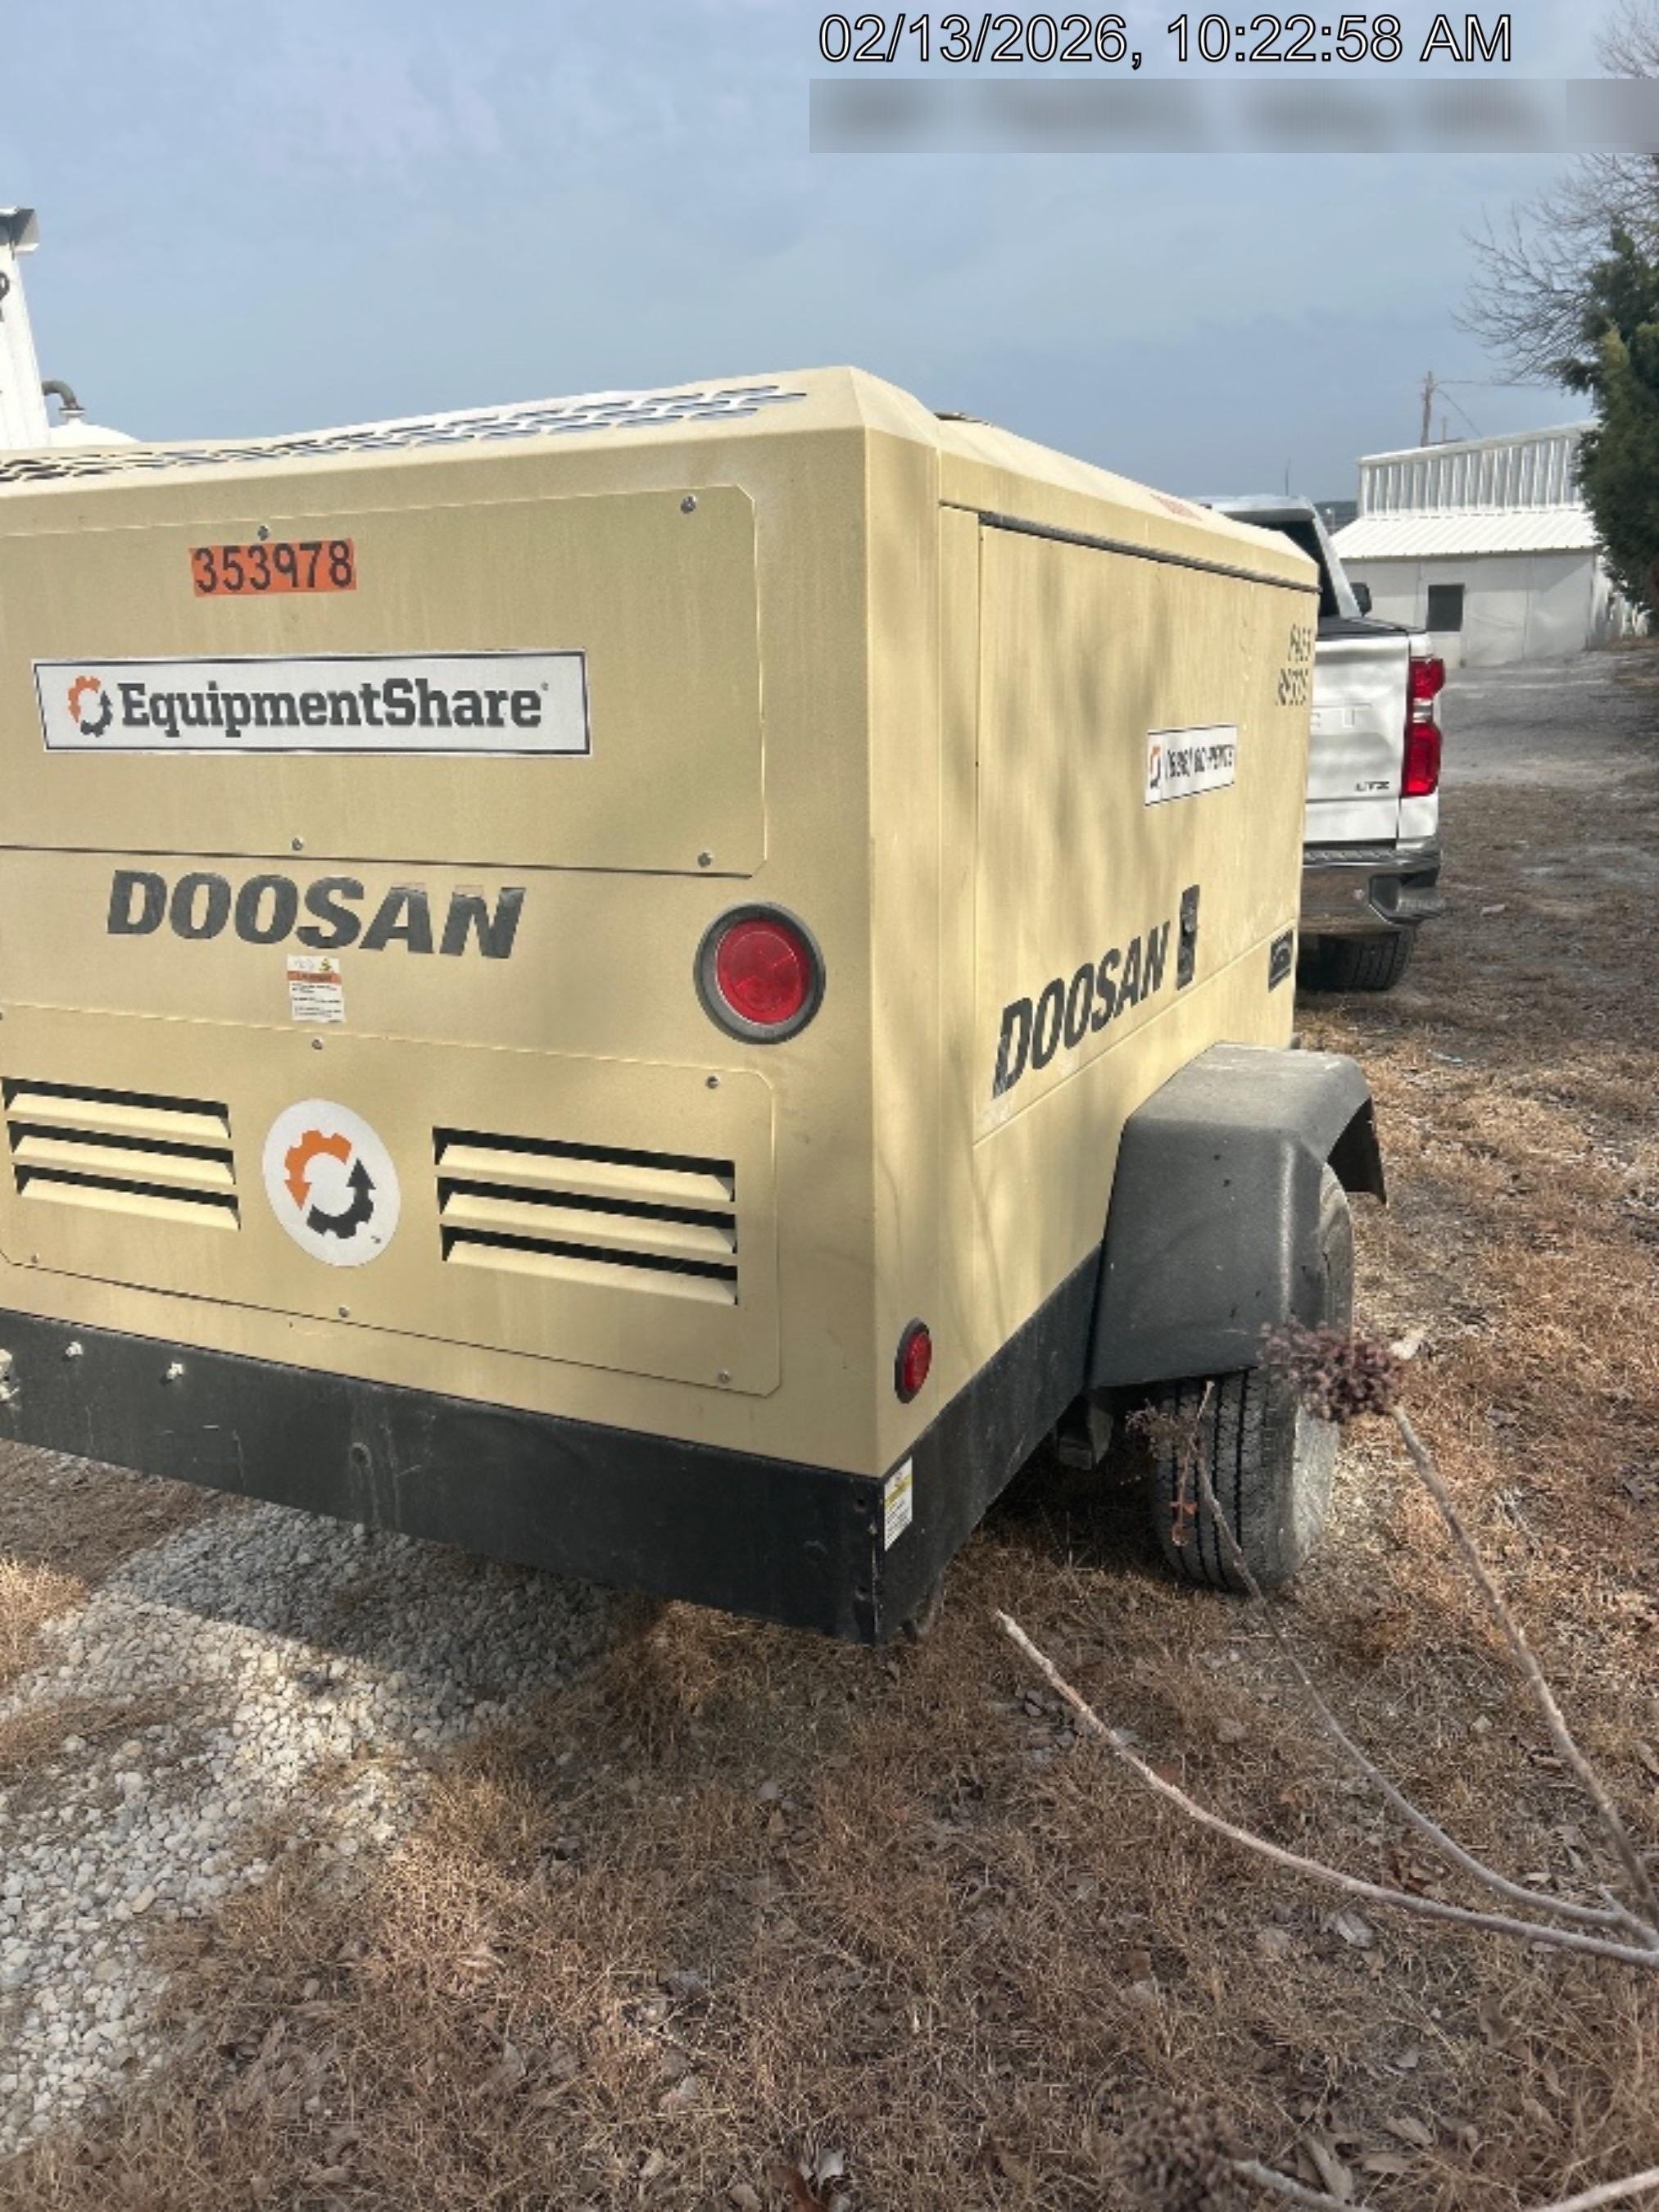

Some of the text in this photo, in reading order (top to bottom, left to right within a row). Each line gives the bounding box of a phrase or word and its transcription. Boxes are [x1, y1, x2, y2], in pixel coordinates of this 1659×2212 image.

[195, 540, 353, 593] 353978
[118, 678, 542, 738] EquipmentShare
[1355, 780, 1389, 792] LTZ
[107, 868, 527, 960] DOOSAN
[992, 920, 1171, 1099] DOOSAN
